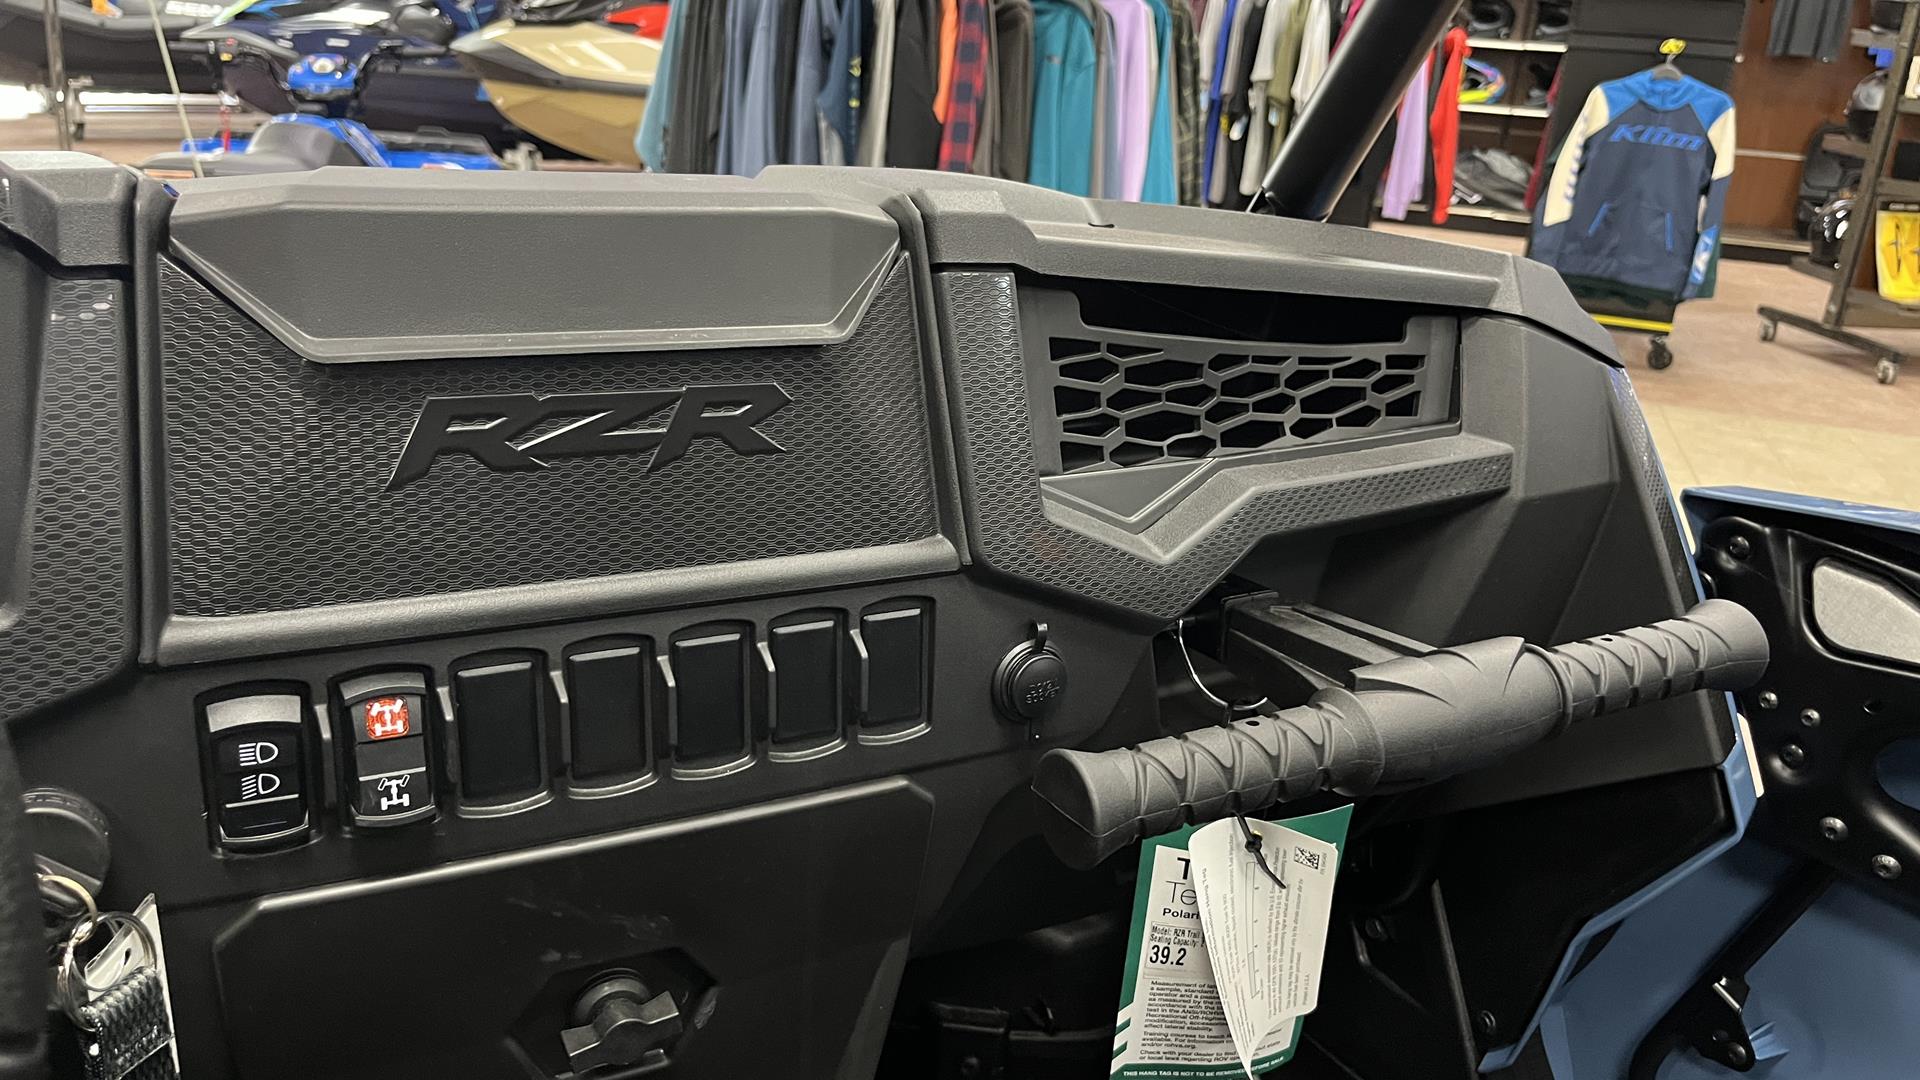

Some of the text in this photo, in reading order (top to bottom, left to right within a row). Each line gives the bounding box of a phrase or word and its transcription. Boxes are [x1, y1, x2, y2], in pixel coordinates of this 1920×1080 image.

[384, 383, 795, 491] RZR
[1177, 857, 1190, 880] T
[1166, 881, 1196, 905] Te
[1163, 908, 1200, 920] Polari
[1150, 933, 1171, 945] Seating
[1152, 926, 1171, 935] Model:
[1149, 945, 1187, 966] 39.2
